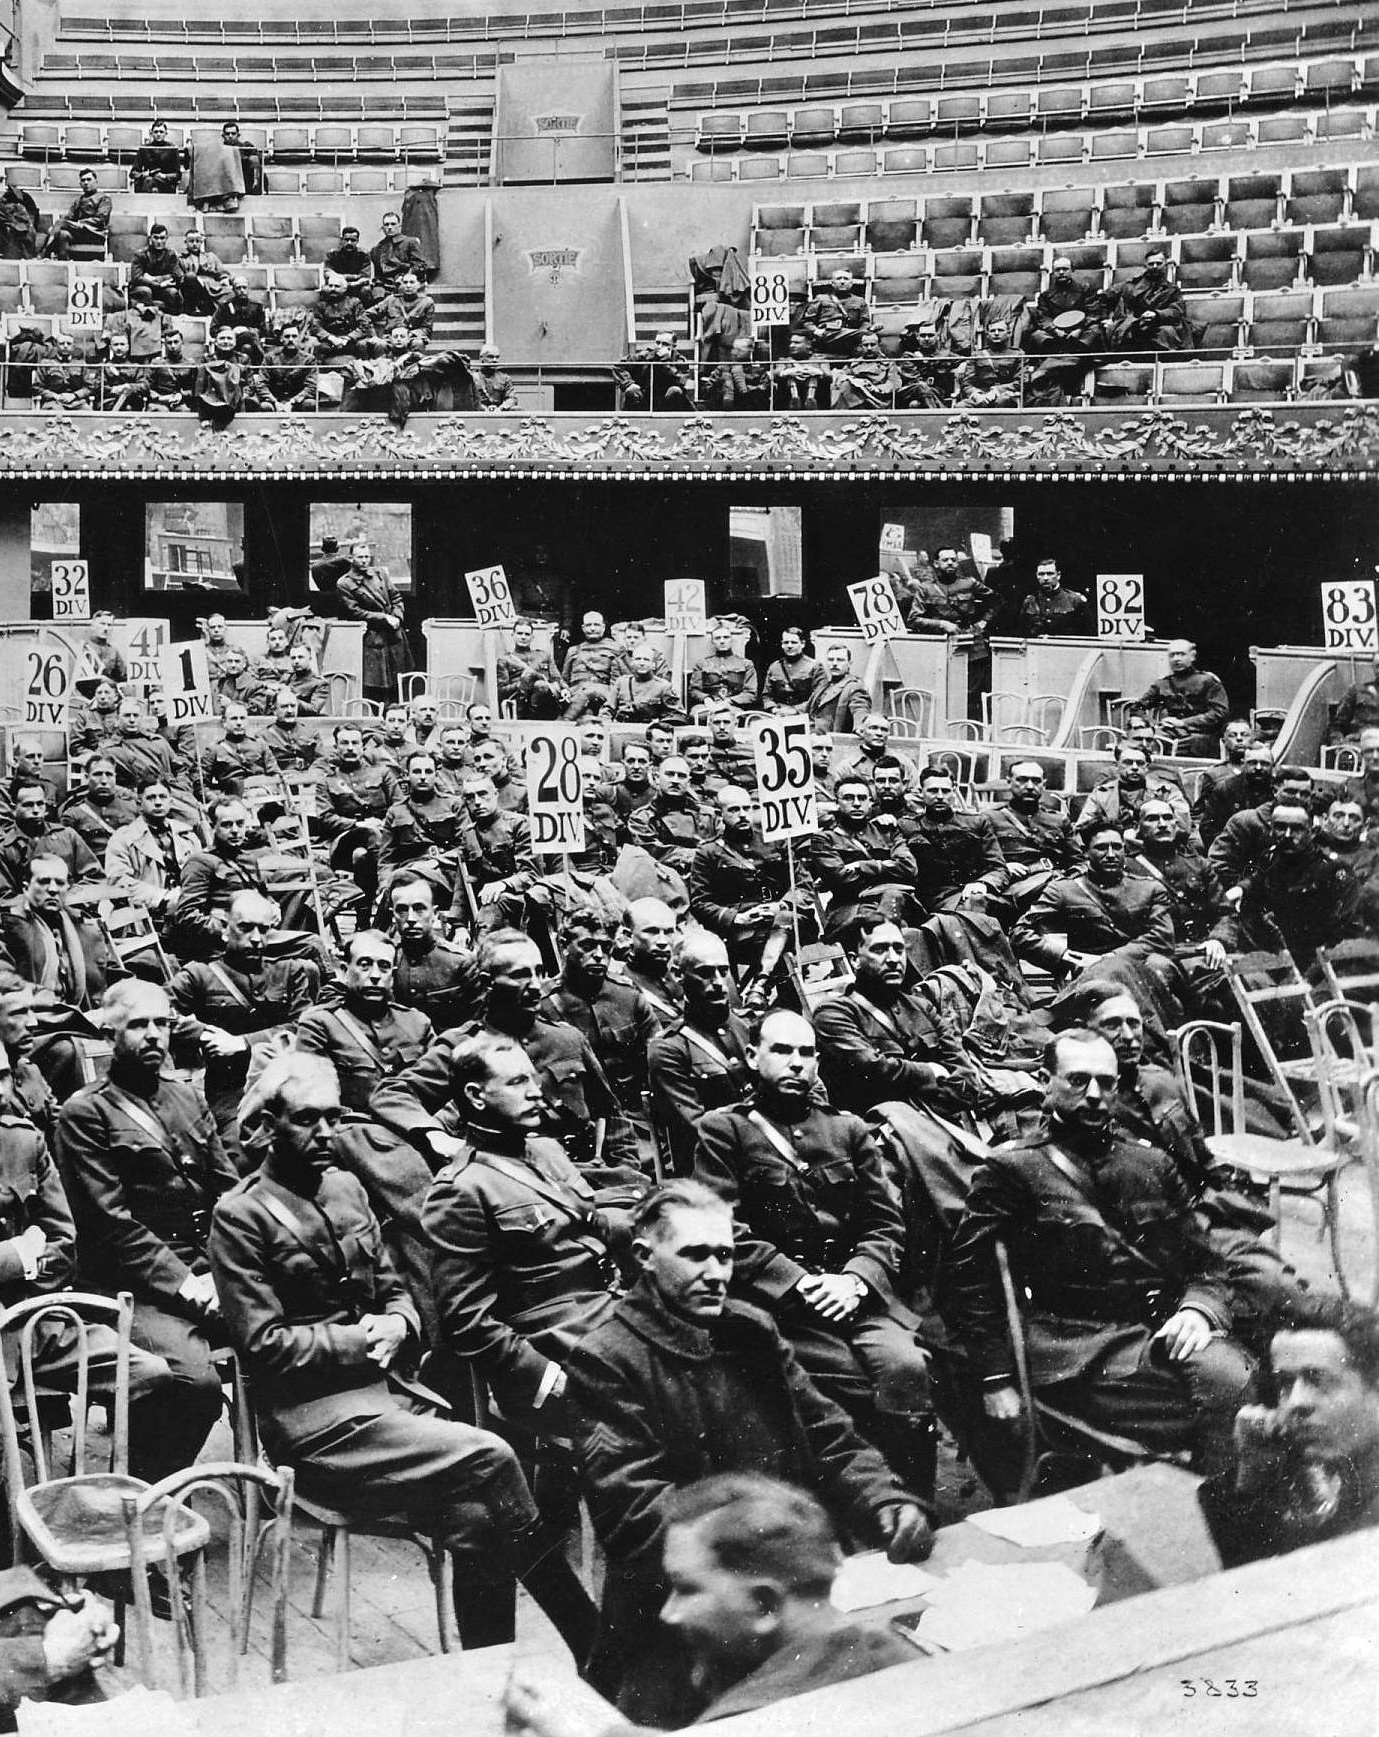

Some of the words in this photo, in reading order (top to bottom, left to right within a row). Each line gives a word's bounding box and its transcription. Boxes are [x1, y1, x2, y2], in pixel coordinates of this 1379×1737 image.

[538, 117, 576, 130] SORTIE
[533, 252, 576, 265] SORTIE
[71, 281, 100, 308] 81
[754, 275, 788, 304] 88
[753, 307, 787, 321] DIV.
[54, 565, 86, 596] 32
[472, 570, 507, 604] 36
[667, 584, 701, 612] 42
[853, 582, 893, 618] 78
[1100, 580, 1143, 614] 82
[1327, 587, 1375, 624] 83
[478, 602, 514, 624] DIV.
[1100, 619, 1143, 635] DIV.
[129, 625, 163, 657] 41
[1328, 628, 1375, 648] DIV.
[28, 652, 66, 697] 26
[179, 649, 196, 691] 1
[26, 702, 64, 725] DIV.
[172, 695, 209, 719] DIV.
[531, 736, 581, 803] 28
[759, 723, 811, 791] 35
[762, 794, 813, 833] DIV.
